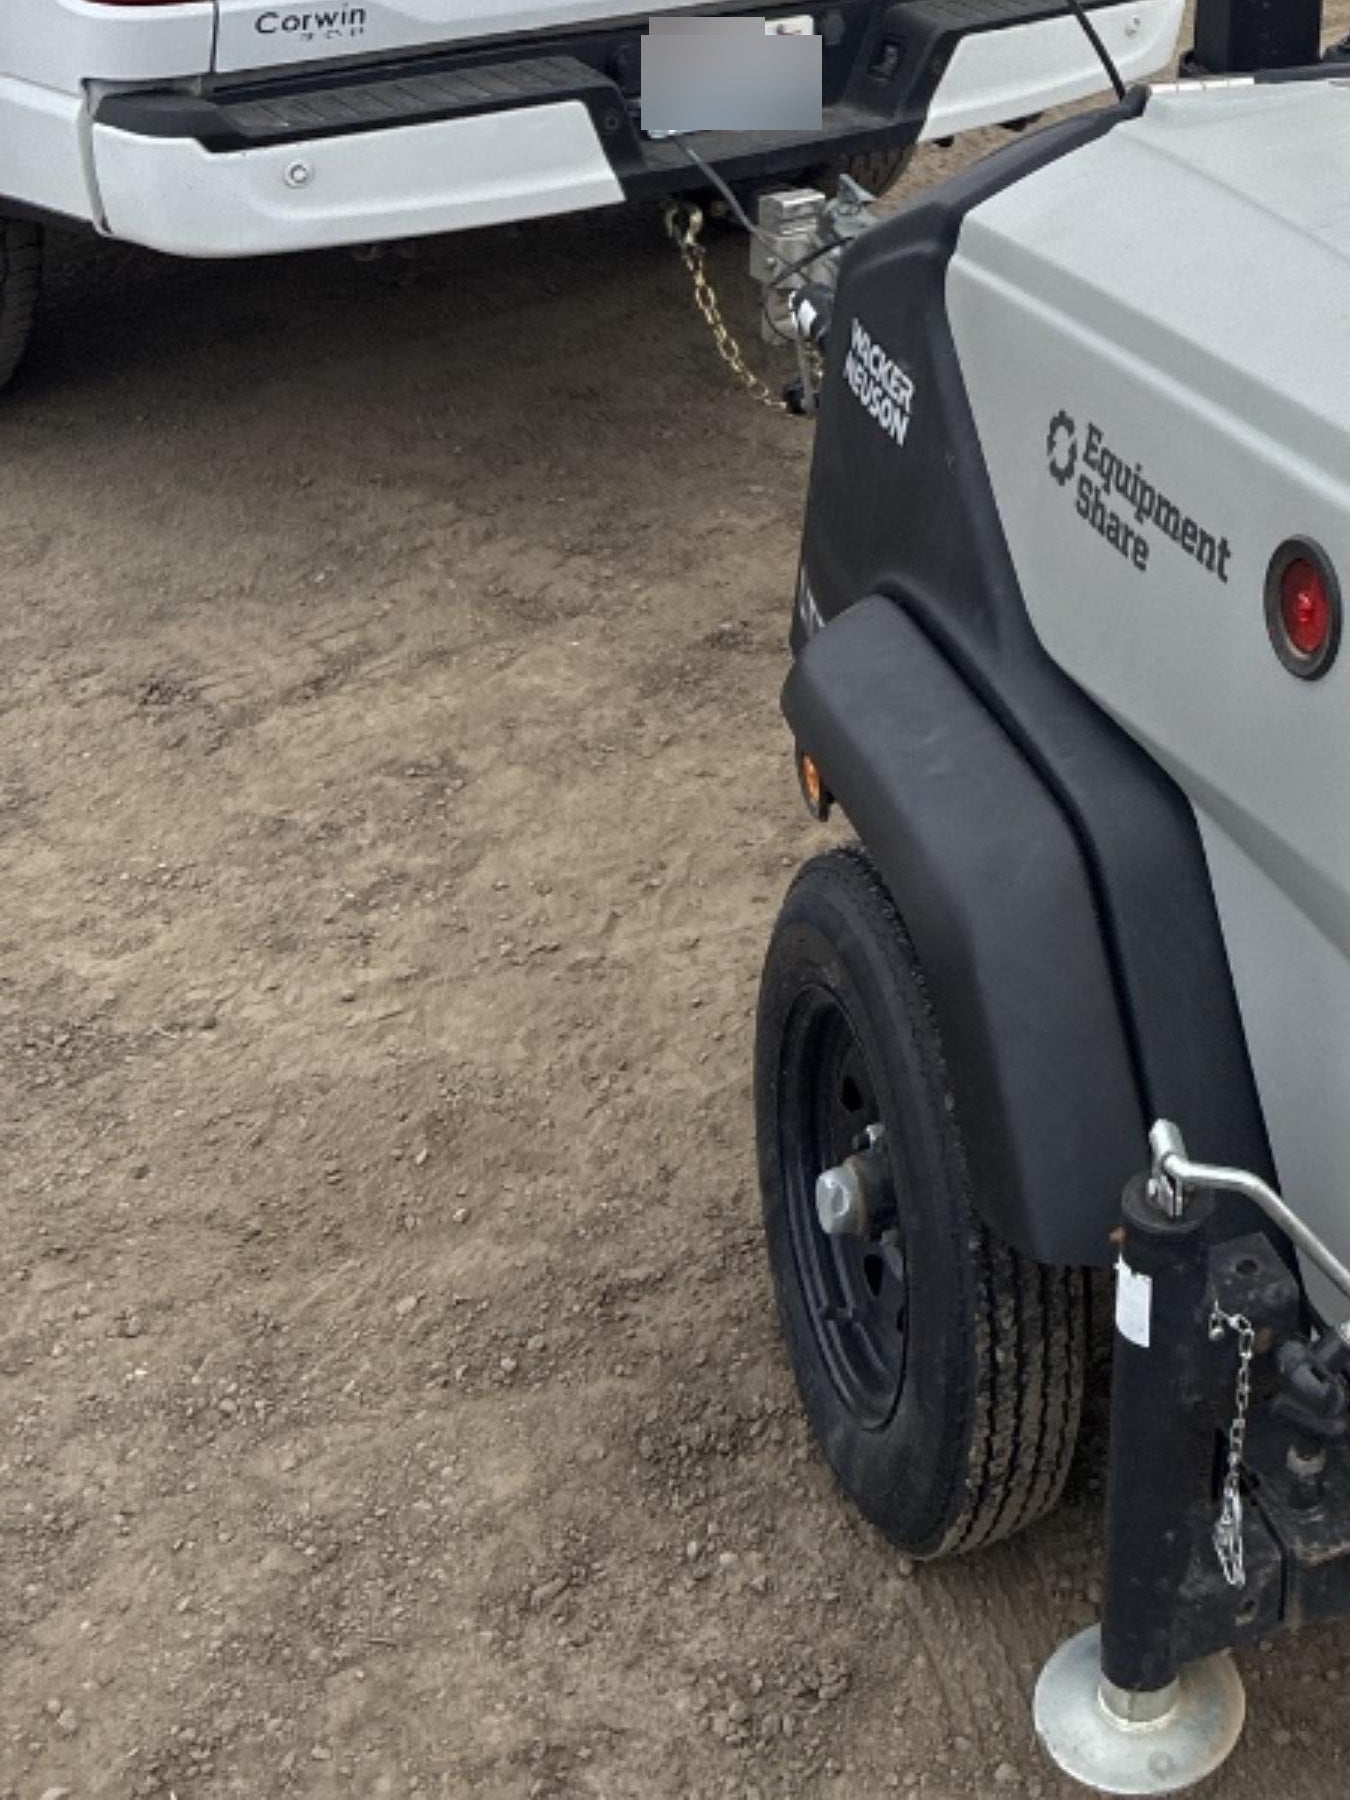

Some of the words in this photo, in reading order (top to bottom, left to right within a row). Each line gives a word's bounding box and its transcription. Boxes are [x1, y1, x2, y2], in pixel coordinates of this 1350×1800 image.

[255, 2, 366, 33] Corwin
[843, 349, 910, 446] NEUSON
[851, 317, 914, 414] WACKER
[1075, 472, 1150, 572] Share
[1082, 421, 1231, 584] Equipment
